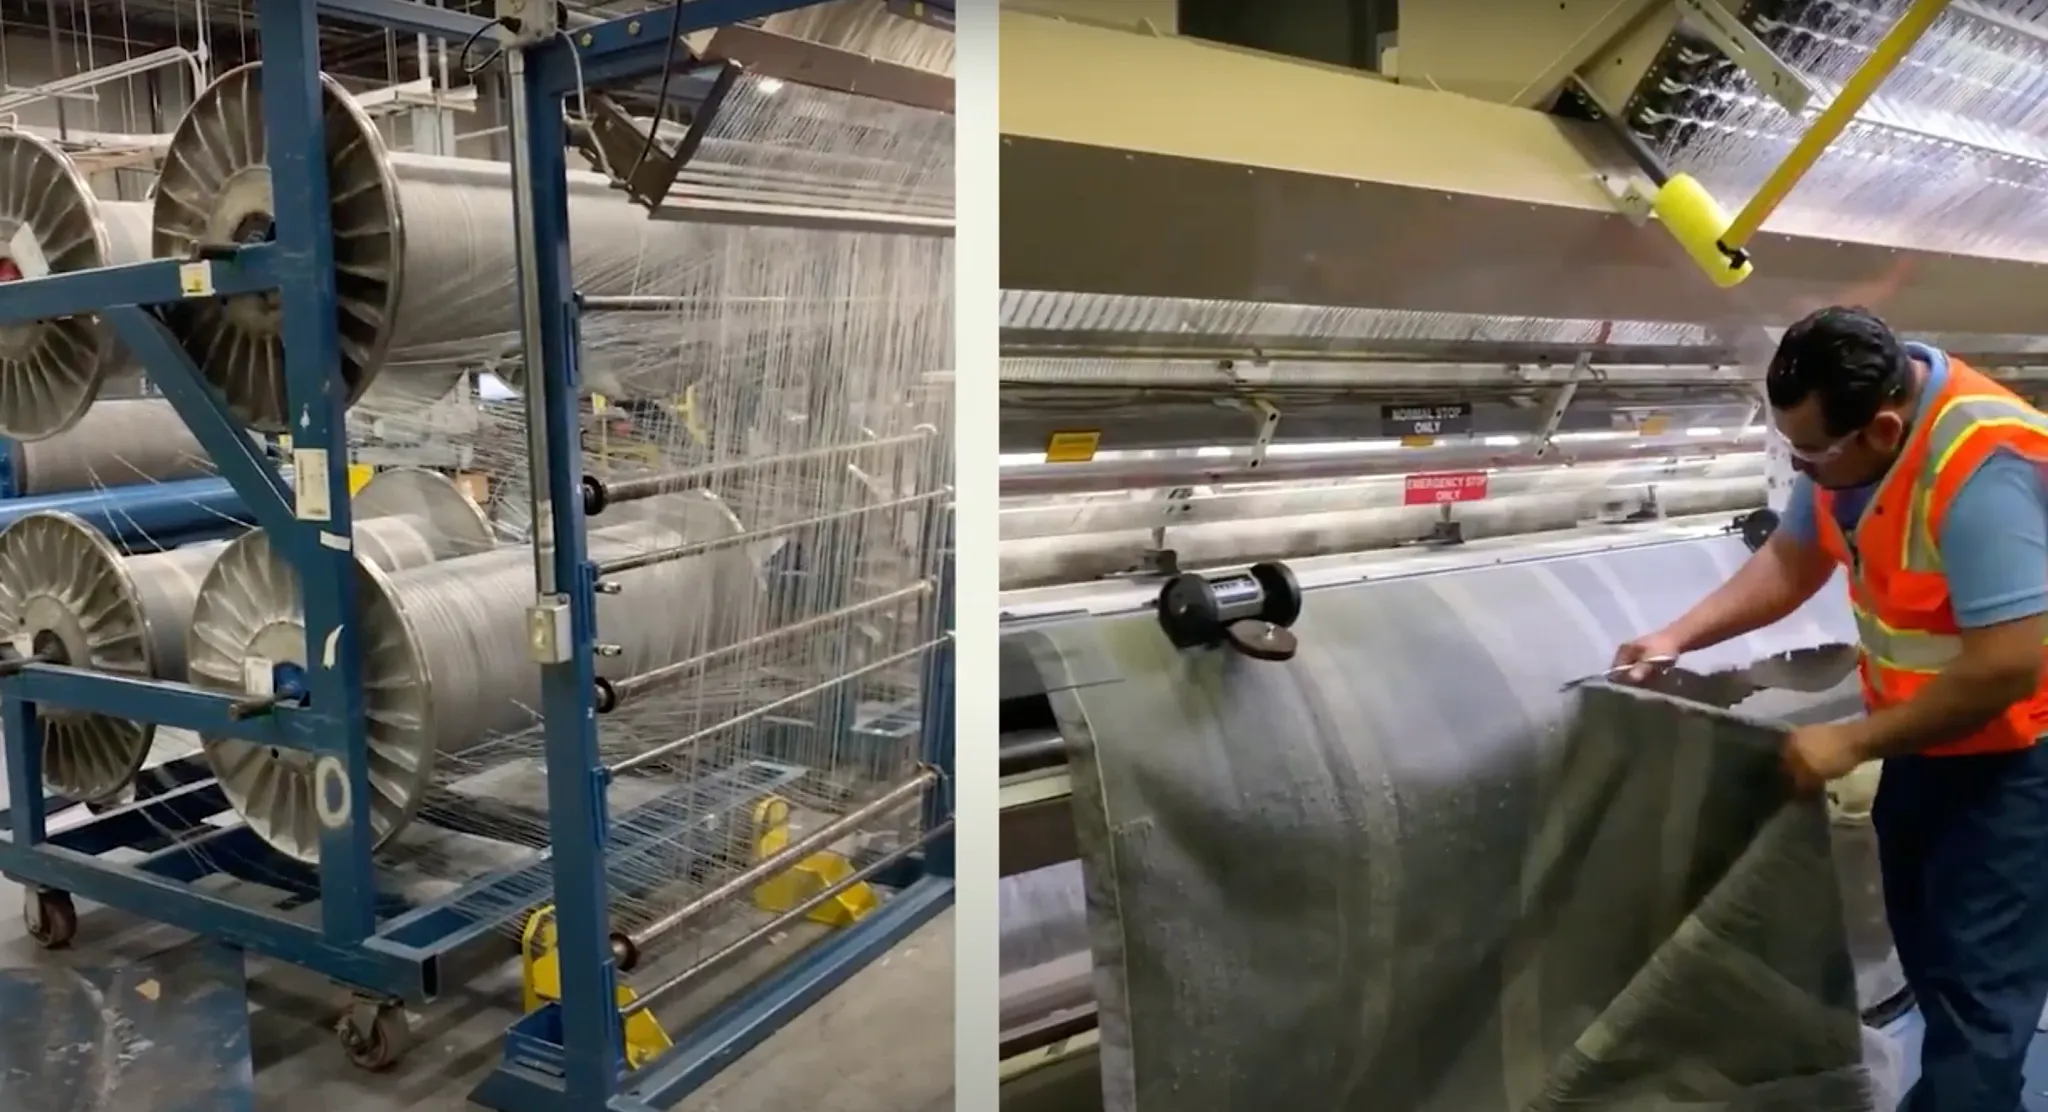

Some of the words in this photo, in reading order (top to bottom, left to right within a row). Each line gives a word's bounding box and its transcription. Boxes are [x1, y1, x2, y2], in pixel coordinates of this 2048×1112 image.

[1392, 407, 1435, 420] NORMAL
[1436, 406, 1462, 418] STOP
[1414, 421, 1440, 433] ONLY
[1407, 477, 1463, 489] EMERGENCY
[1465, 475, 1486, 487] STOP
[1435, 490, 1461, 501] ONLY
